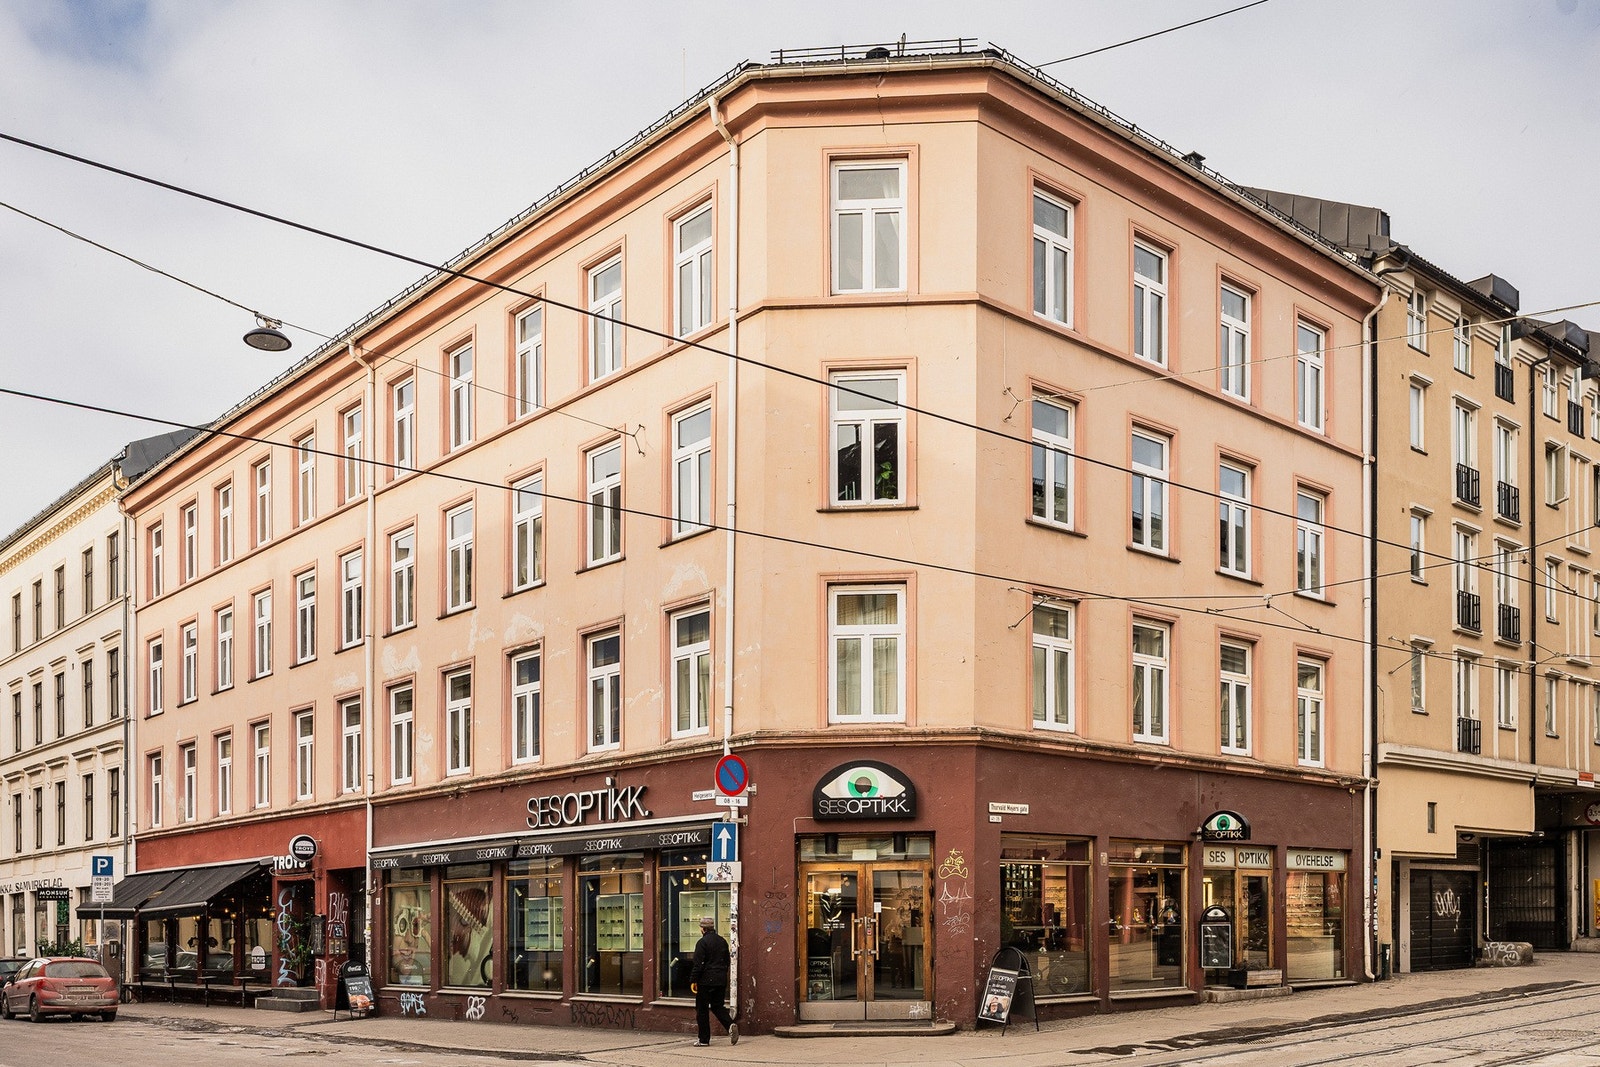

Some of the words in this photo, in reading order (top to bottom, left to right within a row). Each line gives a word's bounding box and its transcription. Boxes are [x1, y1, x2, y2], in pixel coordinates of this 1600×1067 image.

[1209, 850, 1226, 863] SES
[1238, 851, 1269, 865] OPTIKK
[1295, 854, 1334, 867] ØYEHELSE
[97, 858, 109, 873] P
